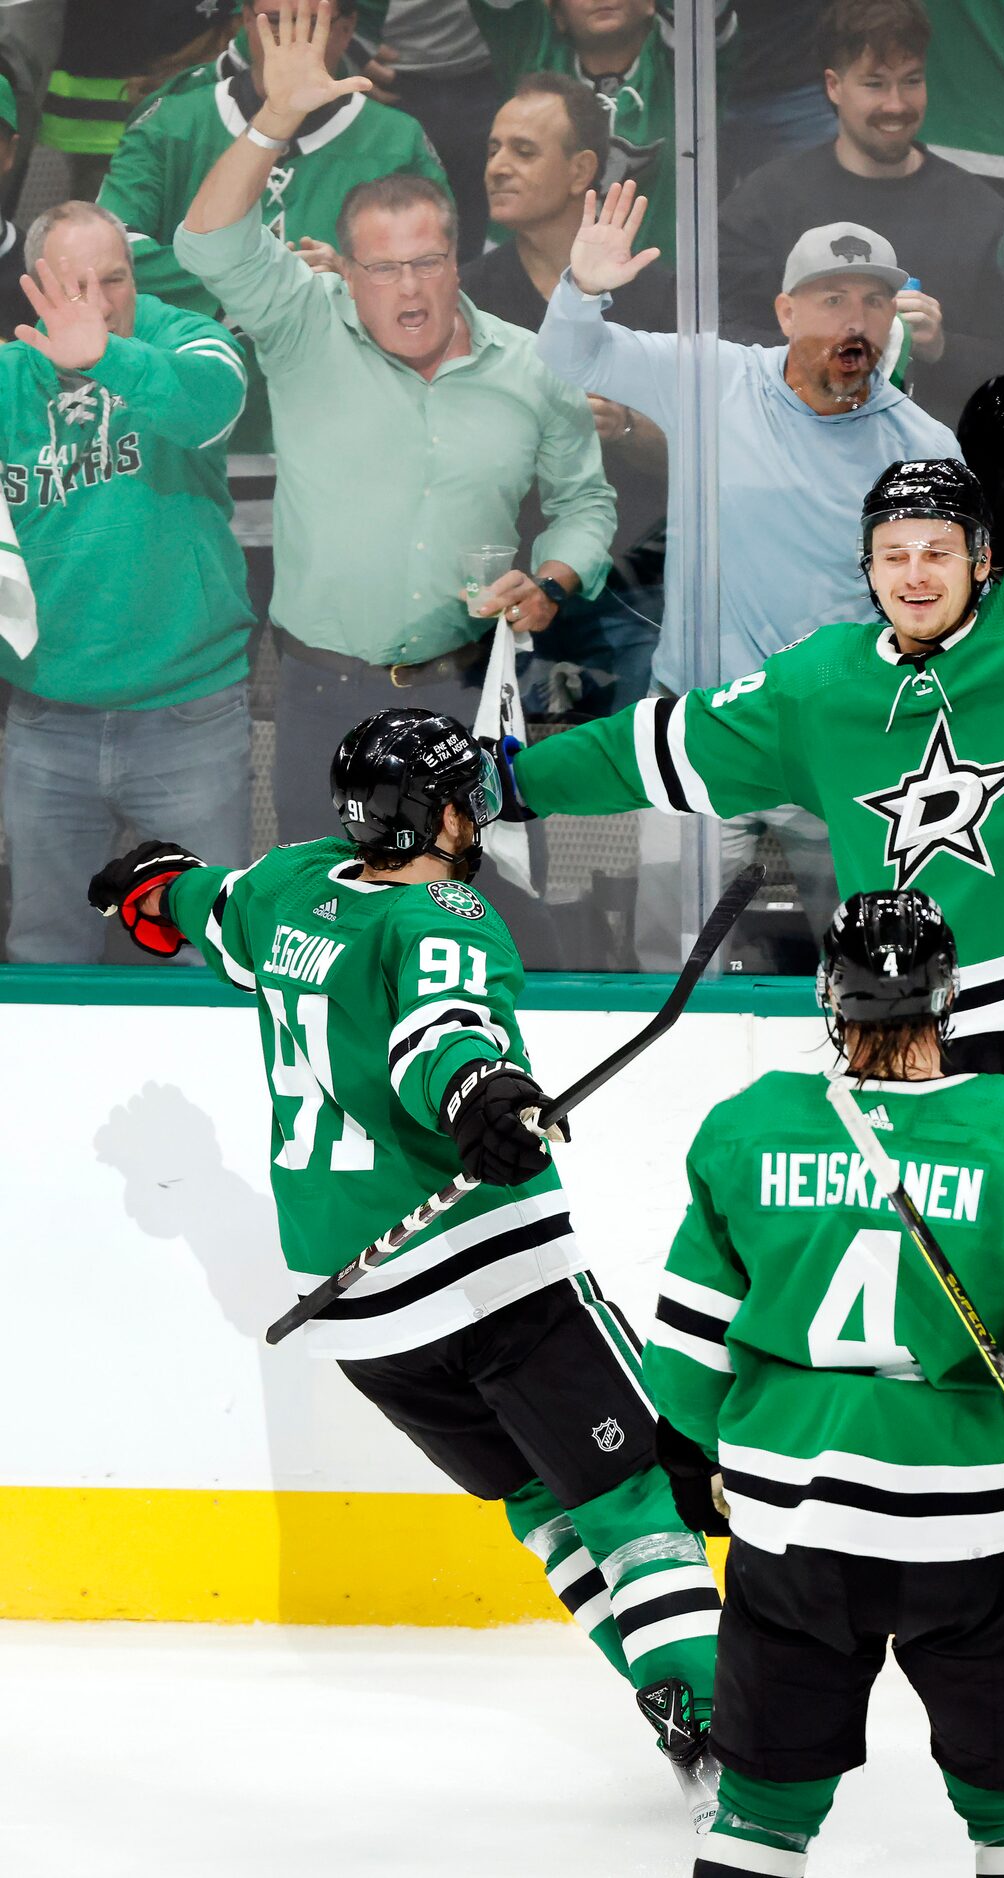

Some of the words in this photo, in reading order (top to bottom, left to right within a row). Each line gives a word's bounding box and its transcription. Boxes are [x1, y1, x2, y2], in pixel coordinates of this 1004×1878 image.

[433, 734, 460, 754] ENERGY
[437, 739, 469, 763] TRANSFER
[347, 799, 366, 823] 91
[312, 907, 337, 922] adidas
[262, 924, 346, 986] SEGUIN
[417, 937, 489, 997] 91
[882, 952, 899, 977] 4
[261, 985, 375, 1171] 91
[760, 1152, 984, 1222] HEISKANEN
[807, 1228, 920, 1374] 4
[945, 1272, 987, 1337] SUPER
